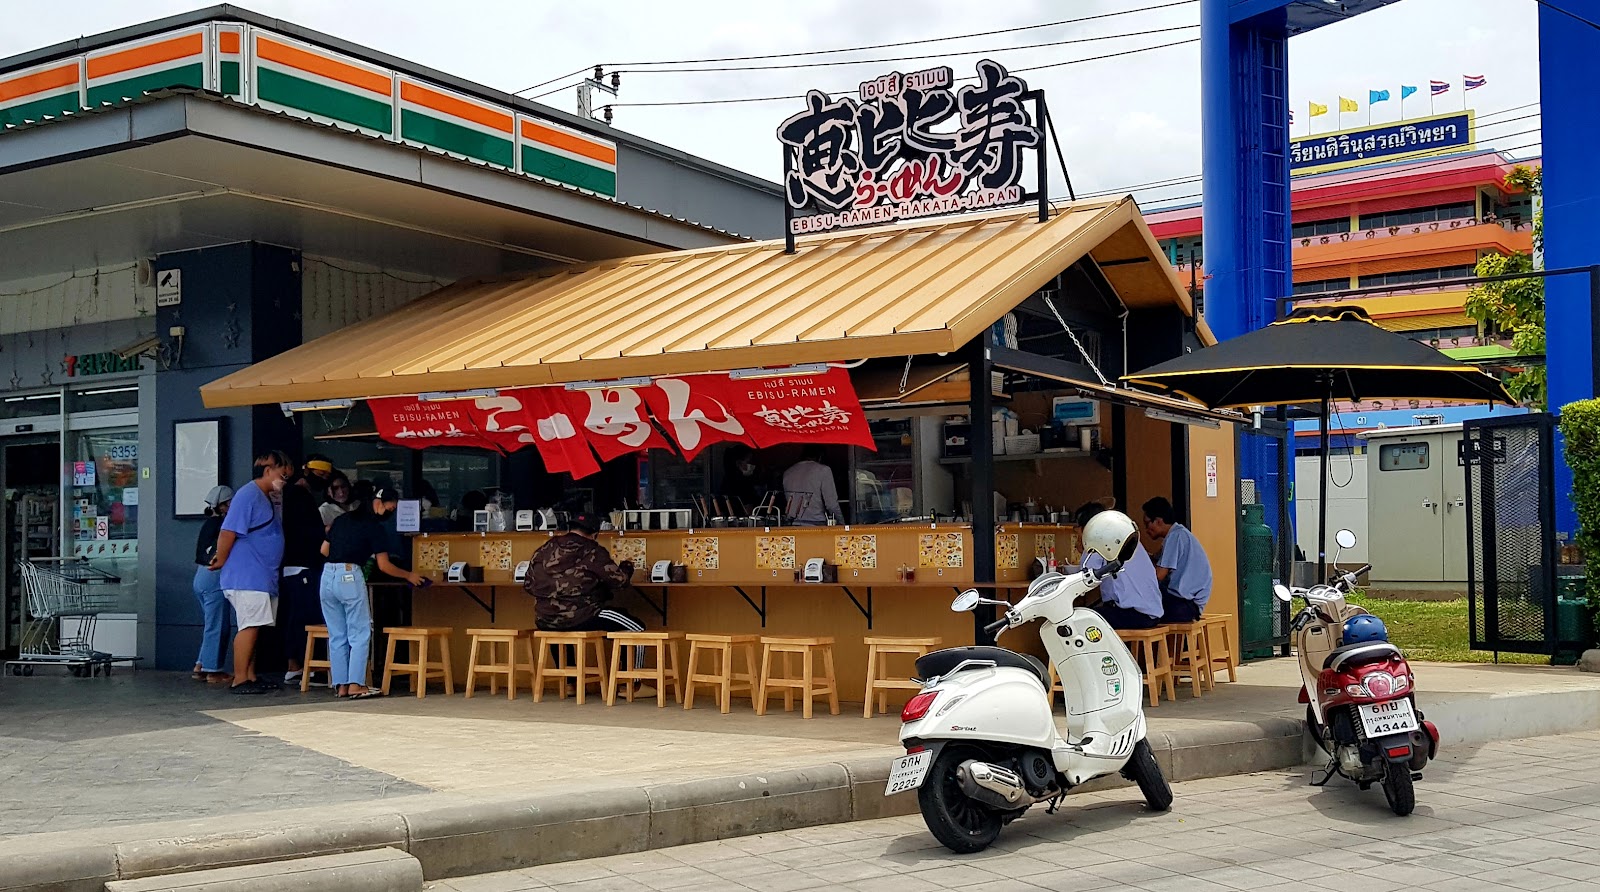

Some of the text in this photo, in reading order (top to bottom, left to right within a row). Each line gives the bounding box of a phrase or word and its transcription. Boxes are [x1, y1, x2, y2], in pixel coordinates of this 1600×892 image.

[906, 69, 946, 89] ราเมน
[792, 188, 1018, 233] EBISU-RAMEN-HAKATA-JAPAN
[747, 386, 836, 400] EBISU-RAMEN
[111, 445, 137, 459] 6353
[1372, 701, 1398, 713] 6กย
[1374, 720, 1409, 733] 4344
[891, 776, 918, 792] 2225
